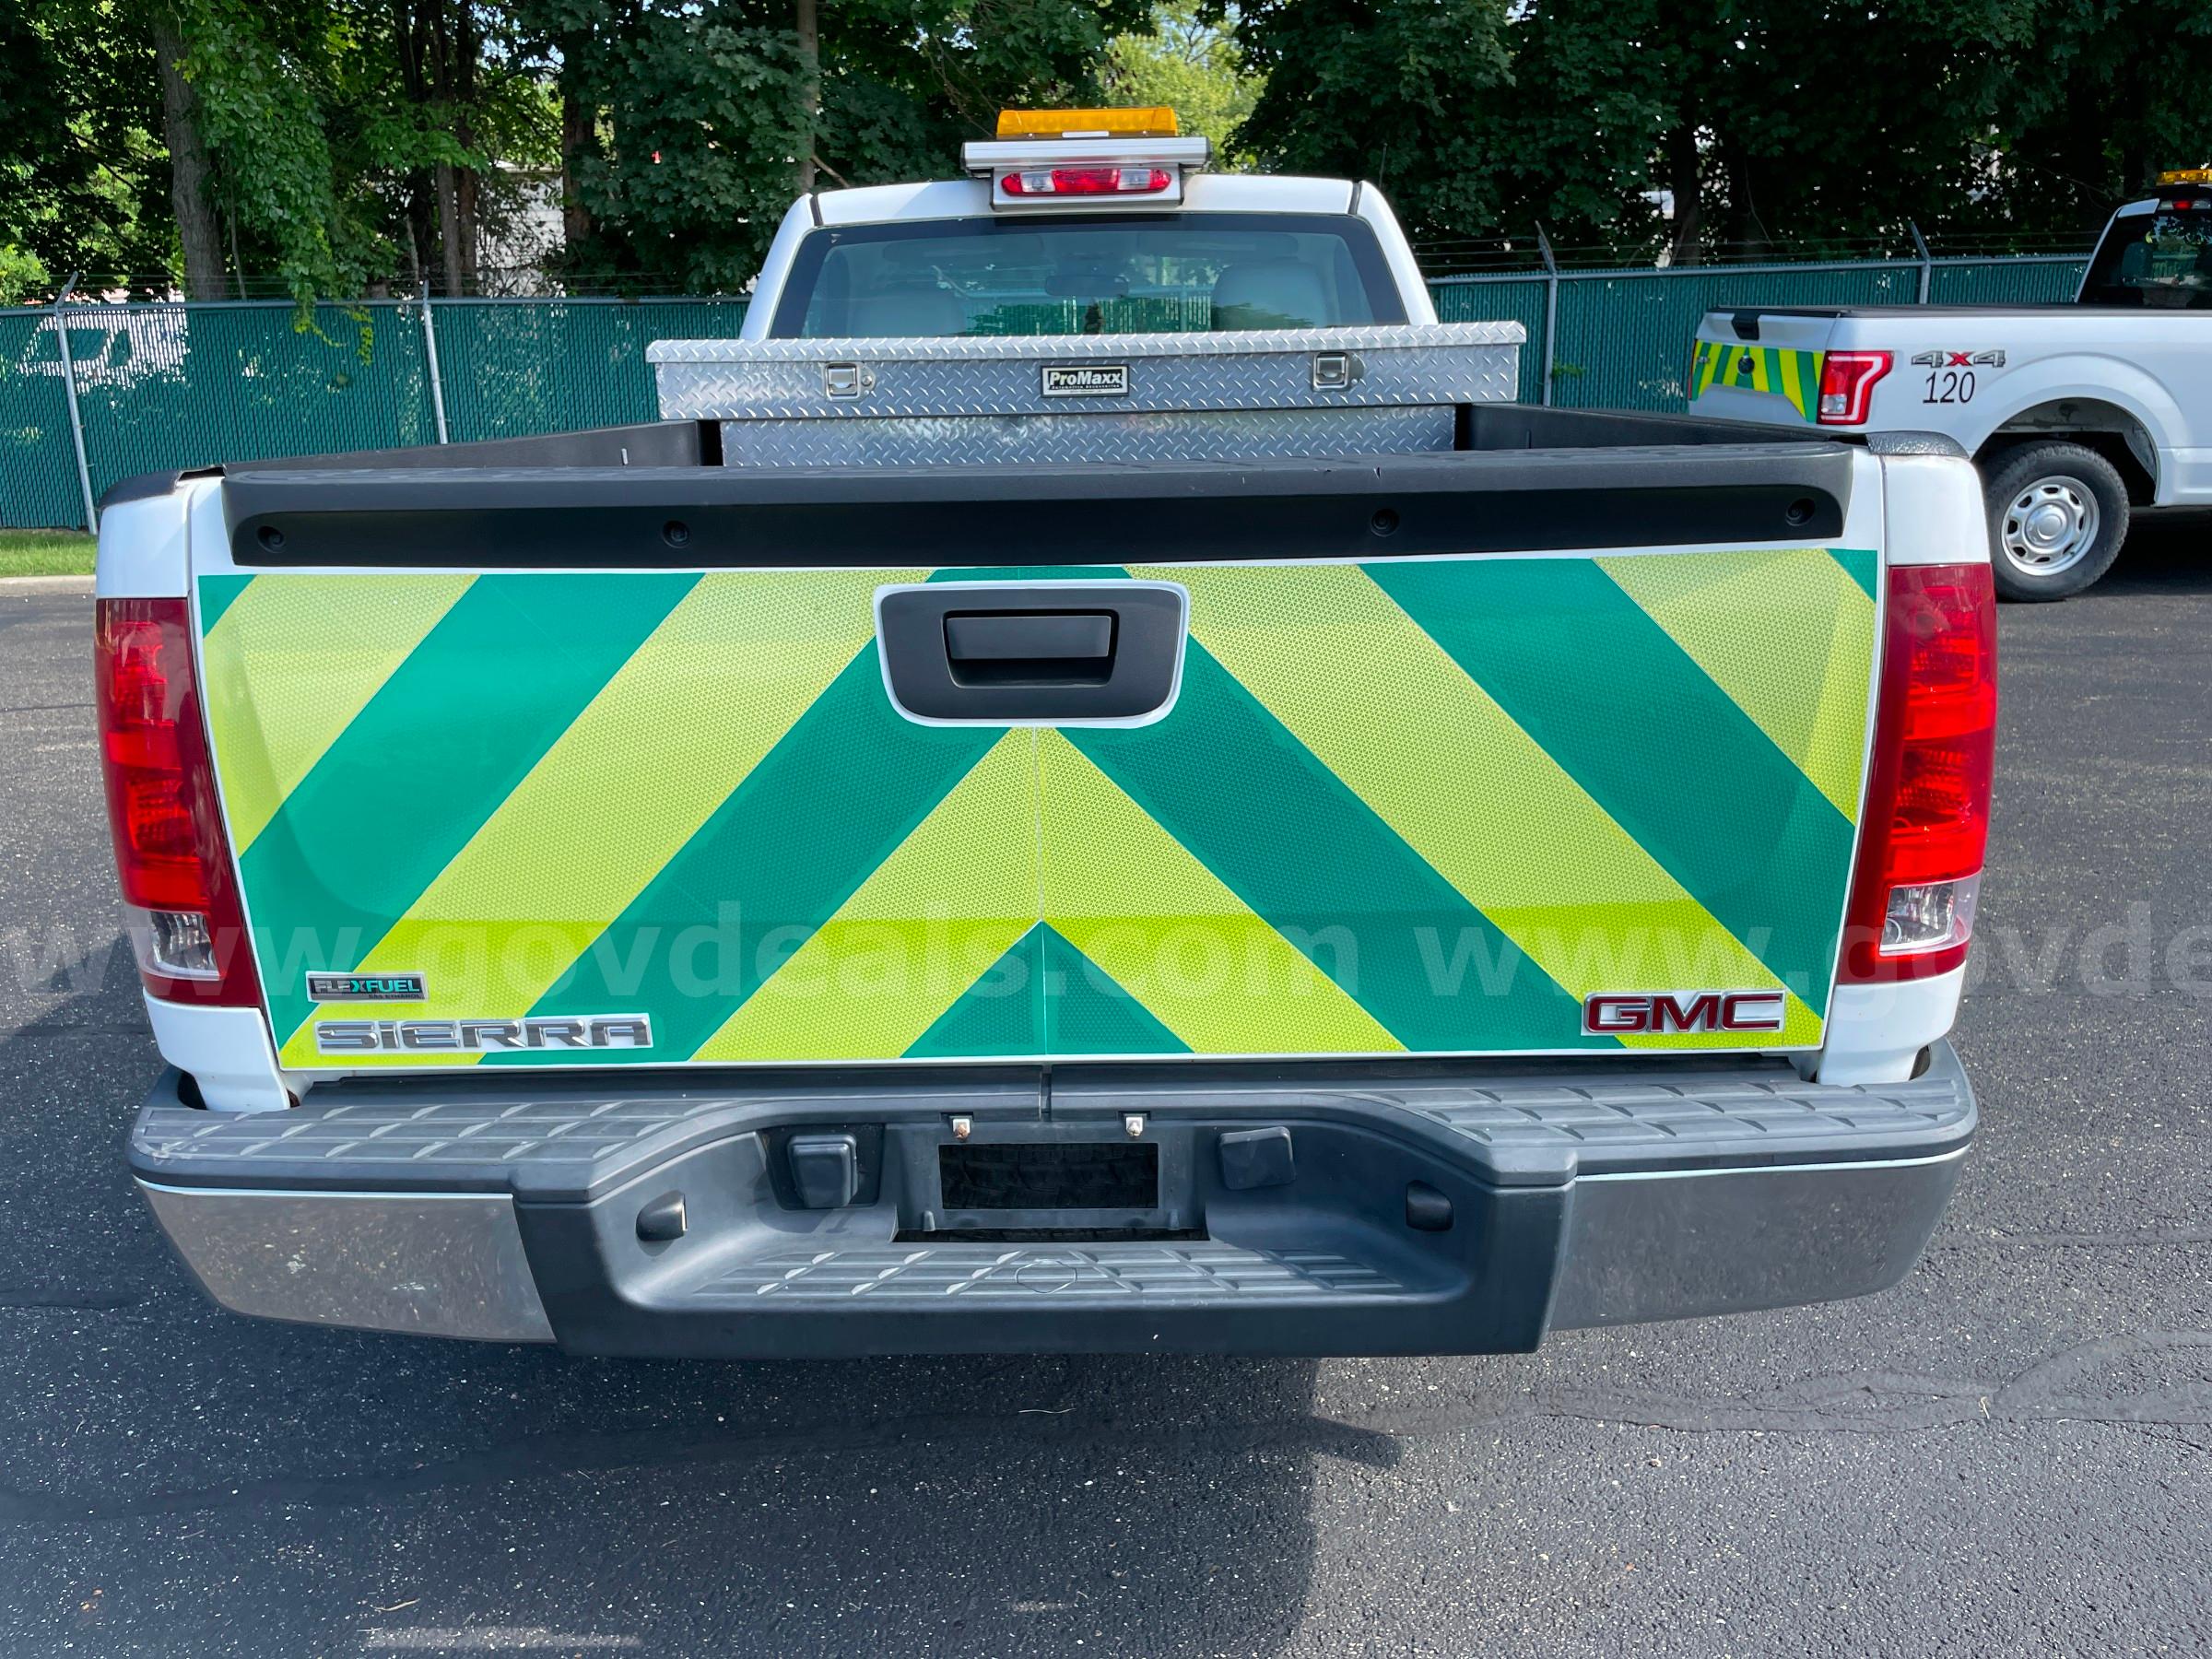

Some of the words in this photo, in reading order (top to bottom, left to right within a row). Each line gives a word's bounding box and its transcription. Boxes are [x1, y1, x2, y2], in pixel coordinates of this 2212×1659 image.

[1050, 371, 1123, 385] ProMaxx
[1923, 371, 1975, 404] 120
[313, 980, 420, 992] FLEXFUEL
[1583, 991, 1783, 1032] GMC
[318, 1018, 651, 1049] SIERRA
